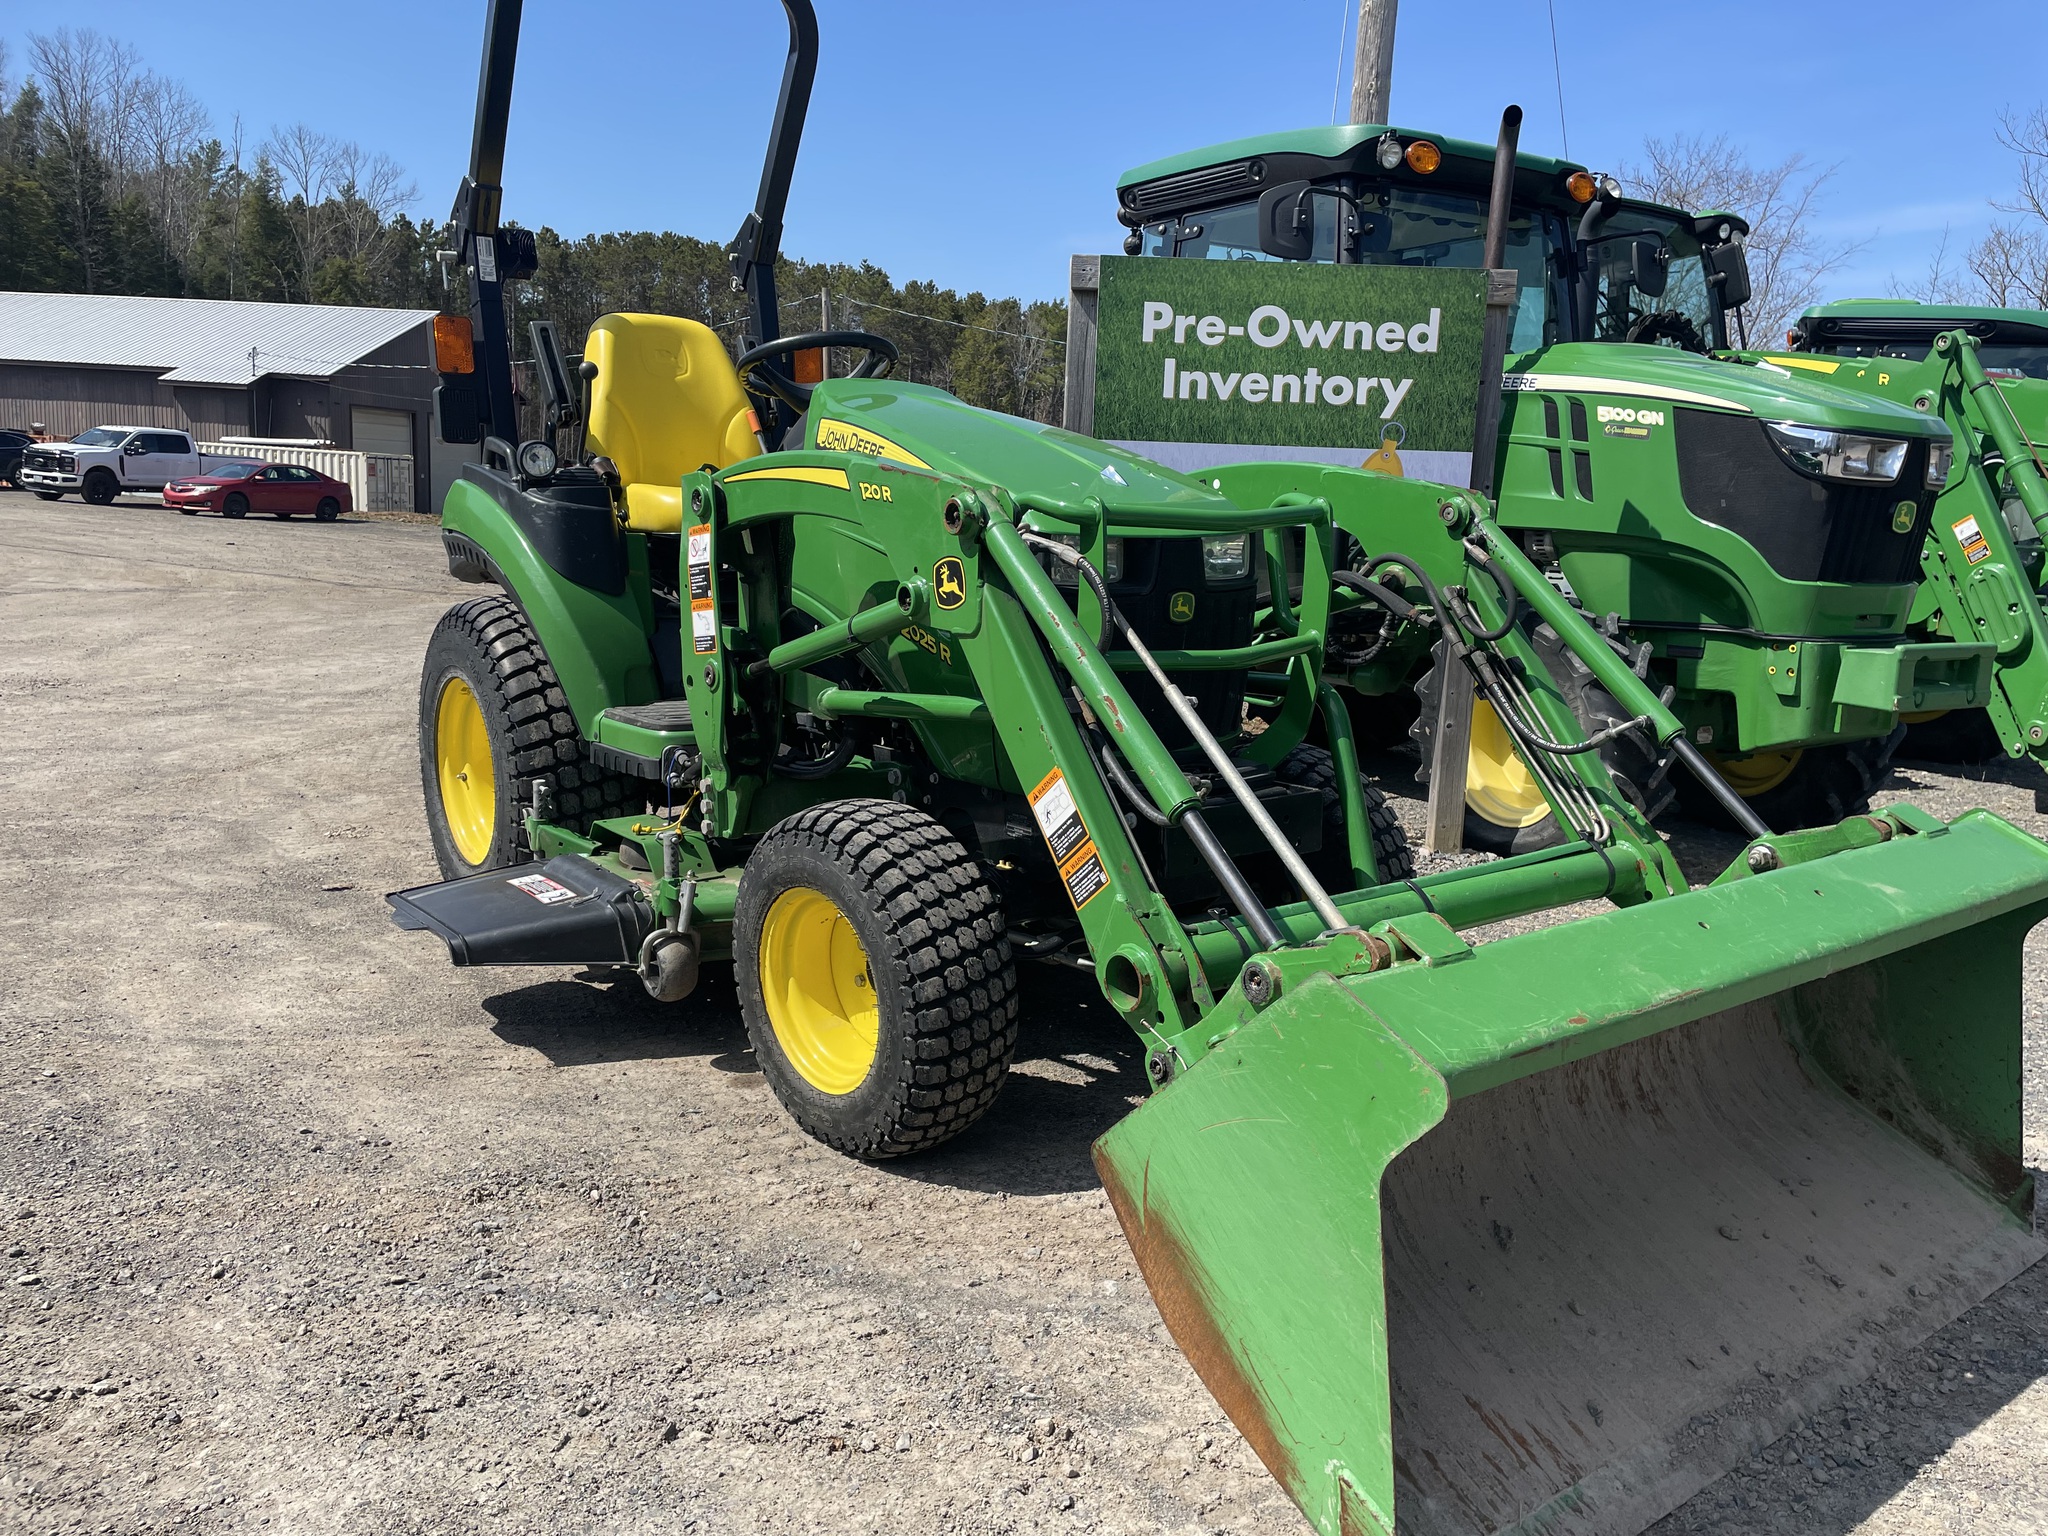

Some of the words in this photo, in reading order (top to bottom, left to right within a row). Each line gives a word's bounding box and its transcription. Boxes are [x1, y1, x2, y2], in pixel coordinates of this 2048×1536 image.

[1142, 300, 1440, 353] Pre-Owned
[1162, 357, 1414, 419] Inventory
[1502, 377, 1538, 389] EERE
[821, 427, 849, 452] JOHN
[849, 432, 886, 457] DEERE
[858, 482, 881, 501] 120
[881, 485, 893, 503] R
[939, 642, 953, 667] R
[1037, 771, 1059, 795] WARNING
[1070, 847, 1093, 870] WARNING
